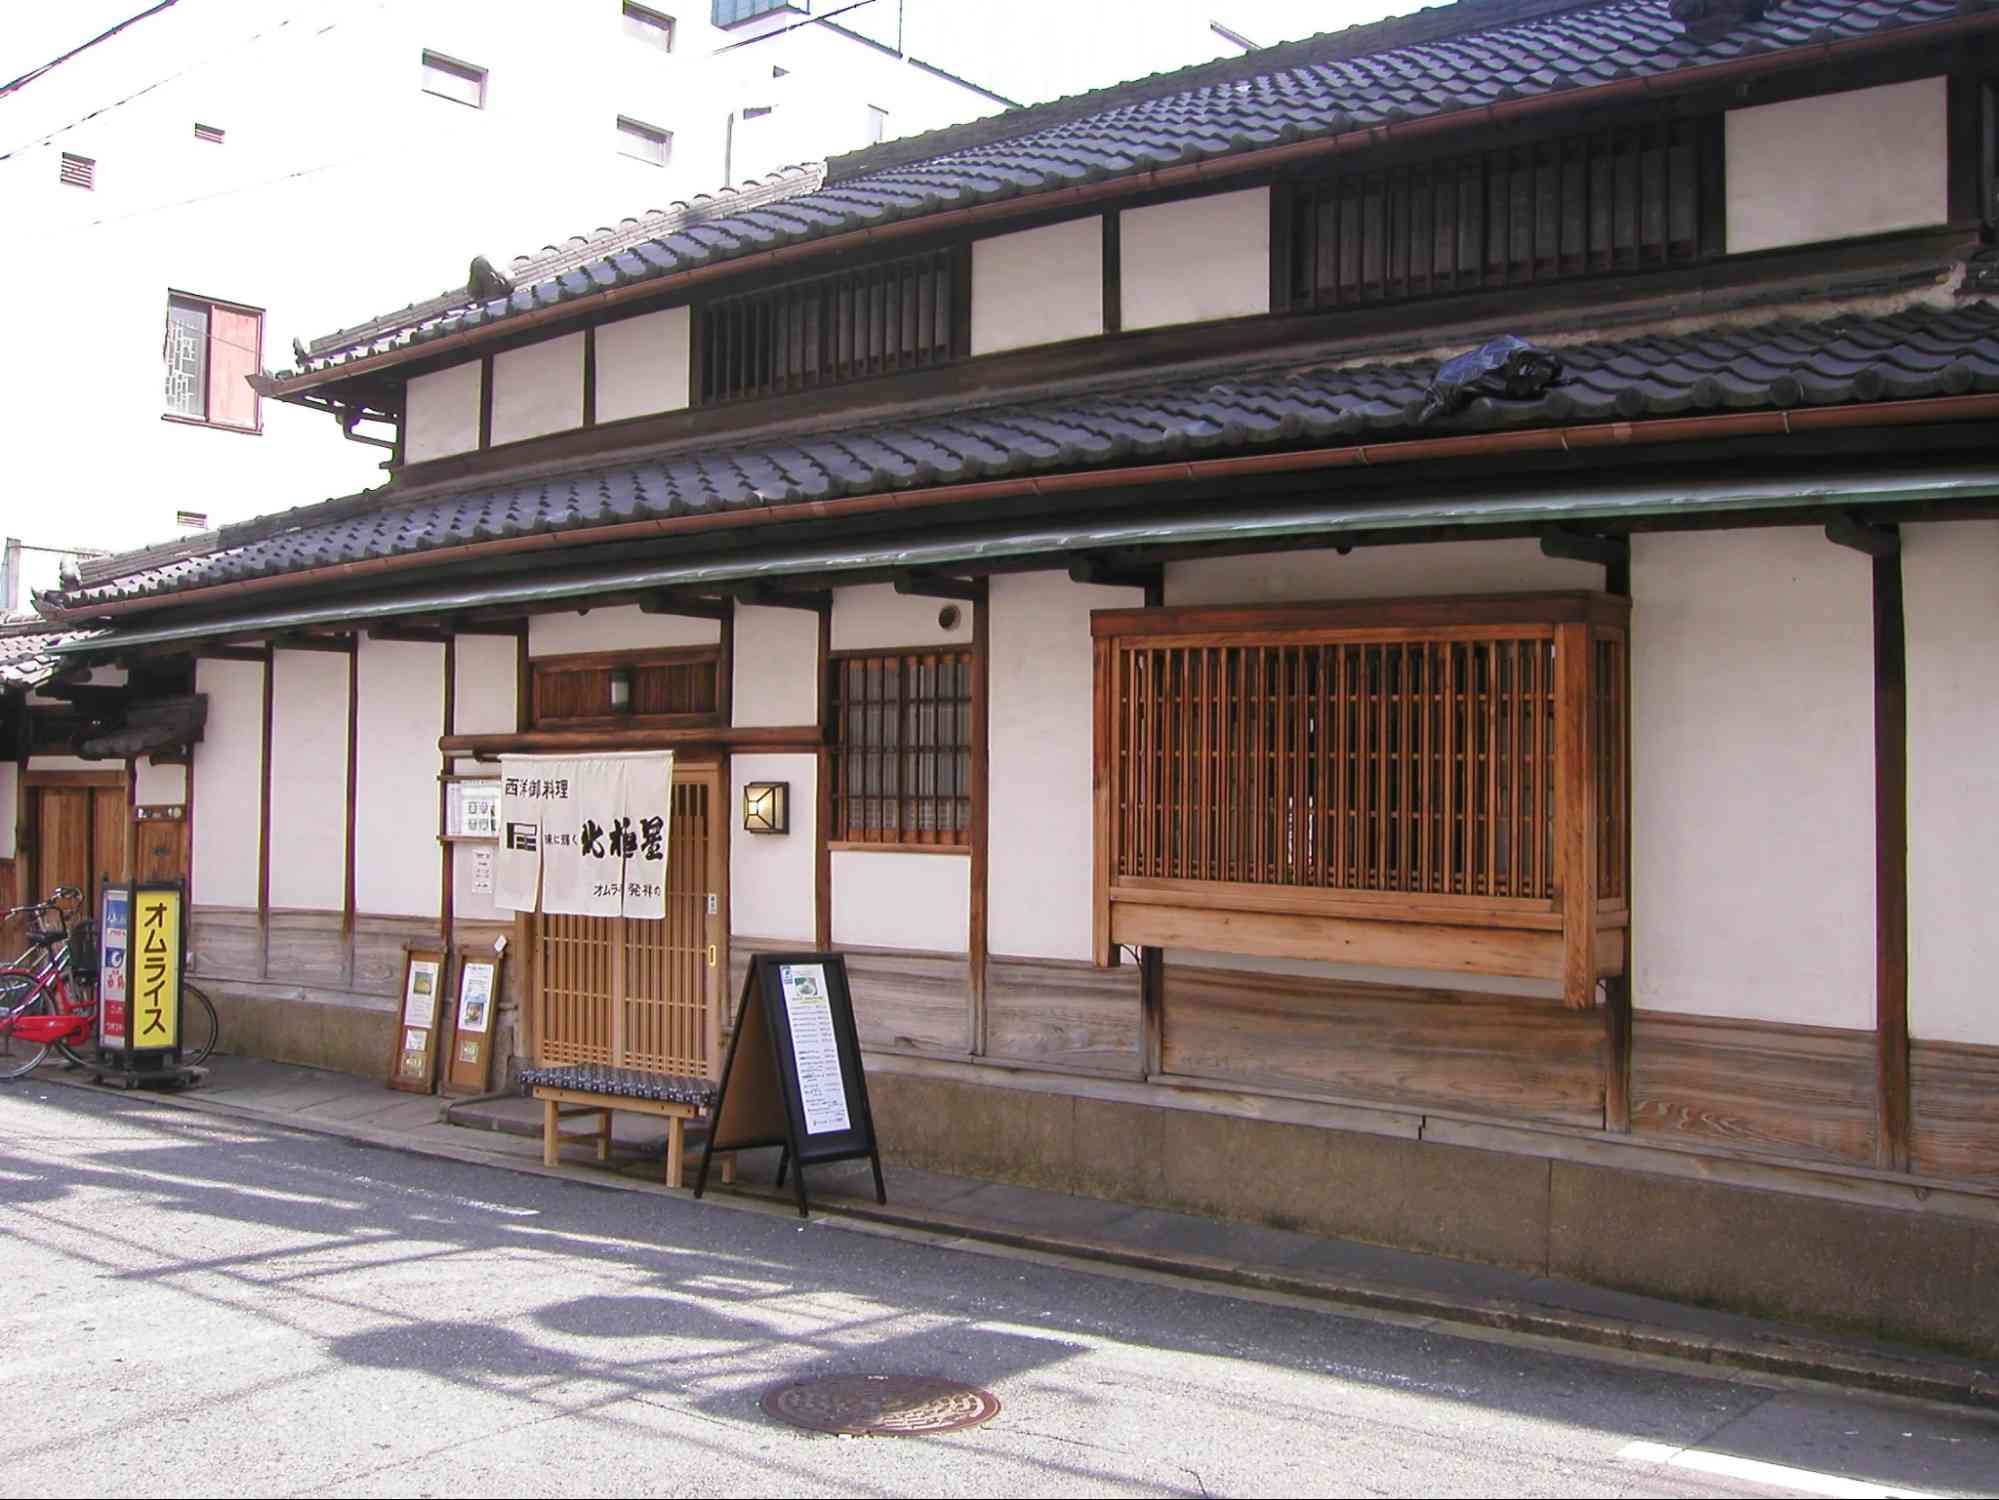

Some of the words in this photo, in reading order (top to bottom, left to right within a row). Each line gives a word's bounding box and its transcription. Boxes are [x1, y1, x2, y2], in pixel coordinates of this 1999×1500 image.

[505, 778, 568, 799] 西洋御料理
[581, 815, 664, 861] 北極星
[143, 902, 168, 1035] オムライス
